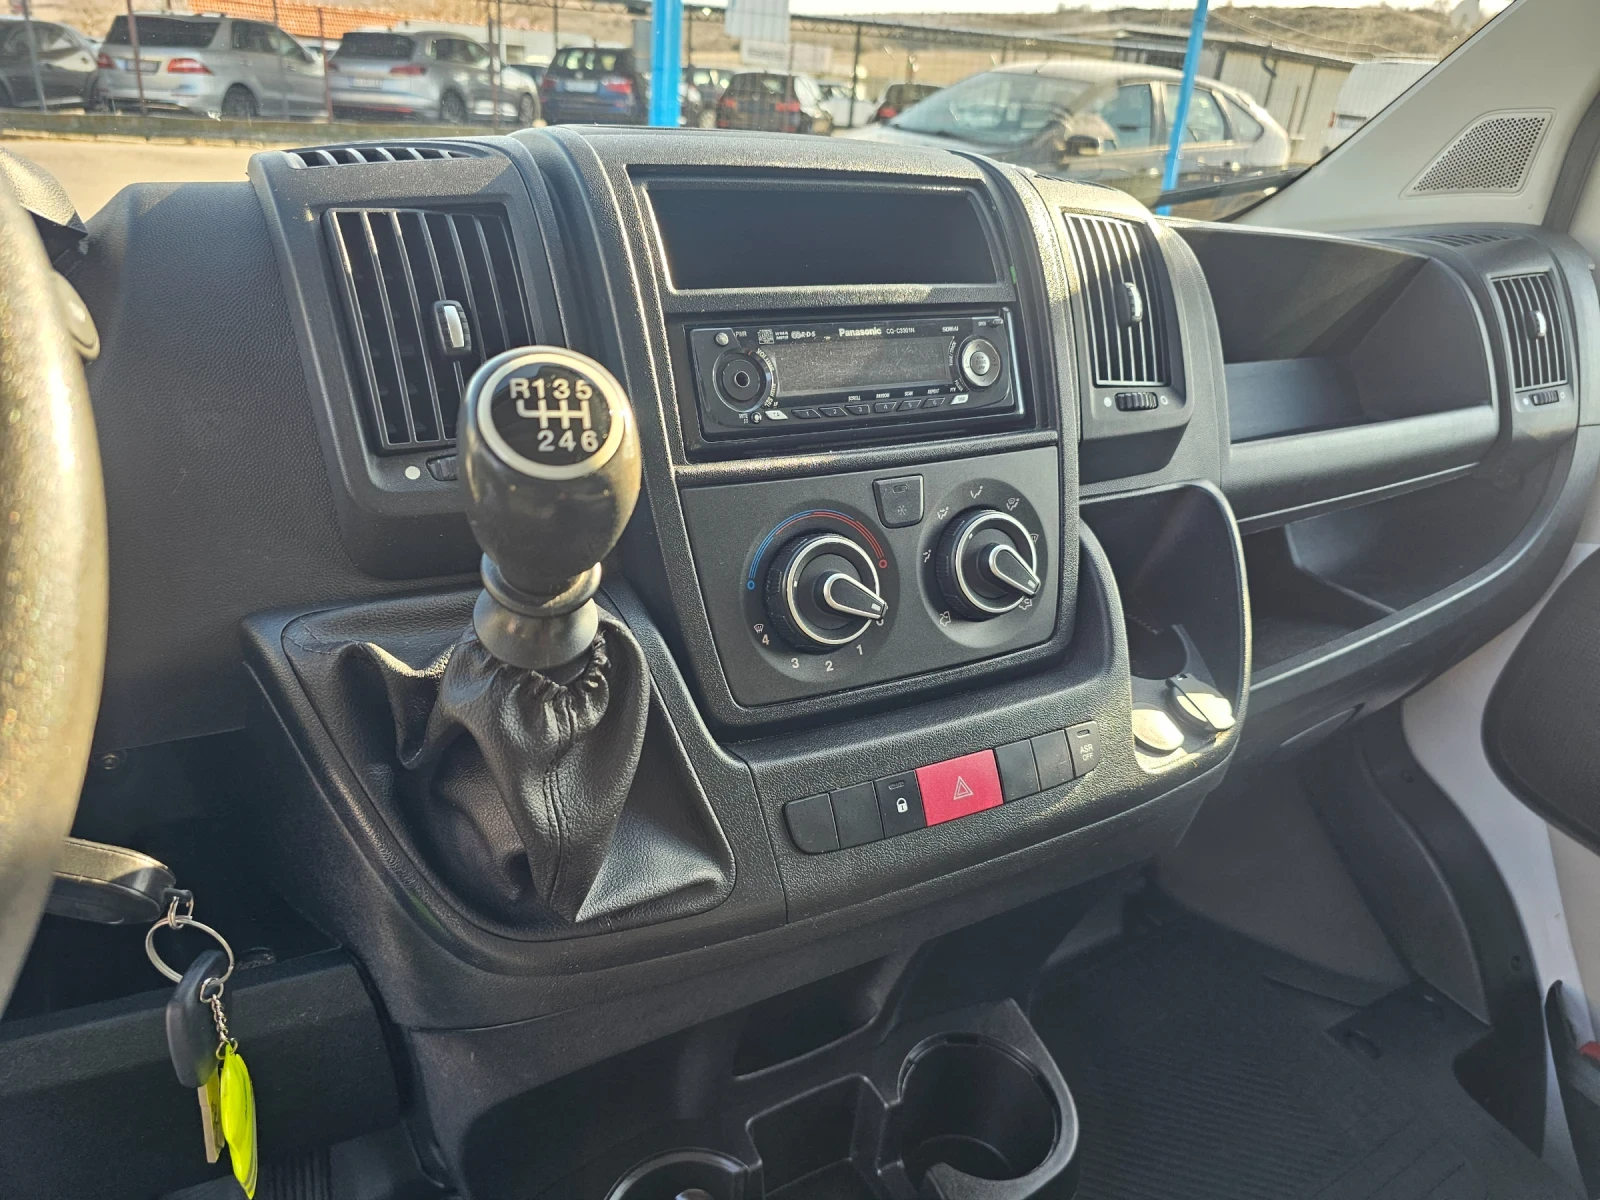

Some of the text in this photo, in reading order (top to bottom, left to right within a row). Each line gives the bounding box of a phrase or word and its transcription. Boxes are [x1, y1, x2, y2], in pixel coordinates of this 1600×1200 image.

[838, 326, 882, 337] Panasonic
[761, 633, 770, 646] 4
[856, 644, 864, 656] 1
[790, 657, 800, 669] 3
[824, 660, 834, 672] 2
[1080, 743, 1094, 755] ASR
[1082, 752, 1094, 762] OFF
